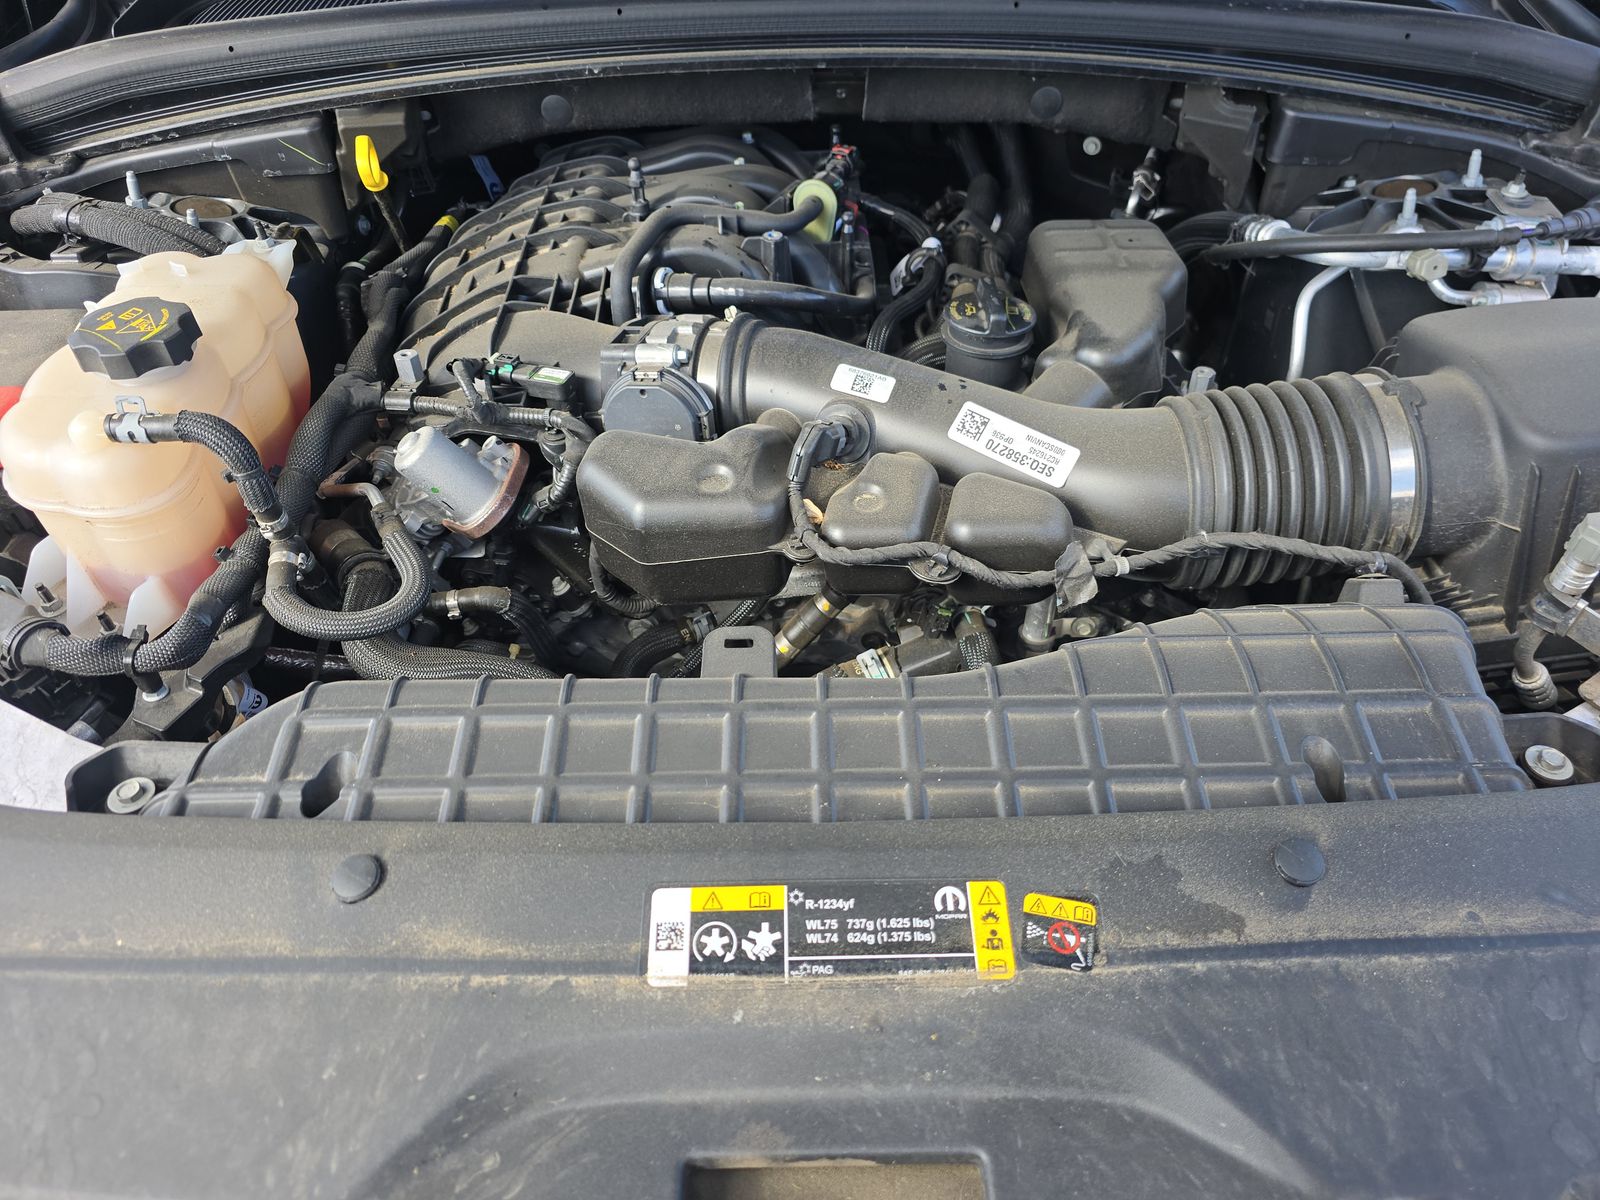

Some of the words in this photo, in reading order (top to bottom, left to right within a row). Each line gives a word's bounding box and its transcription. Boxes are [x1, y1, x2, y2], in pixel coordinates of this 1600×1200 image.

[985, 438, 1056, 478] SEQ:358270
[805, 898, 855, 912] R-1234yf
[805, 919, 839, 930] WL75
[846, 918, 875, 931] 737g
[876, 917, 911, 932] (1.625
[912, 917, 936, 931] lbs)
[806, 933, 839, 944] WL74
[846, 932, 876, 945] 624g
[877, 931, 912, 946] (1.375
[913, 931, 936, 944] lbs)
[811, 964, 835, 976] PAG
